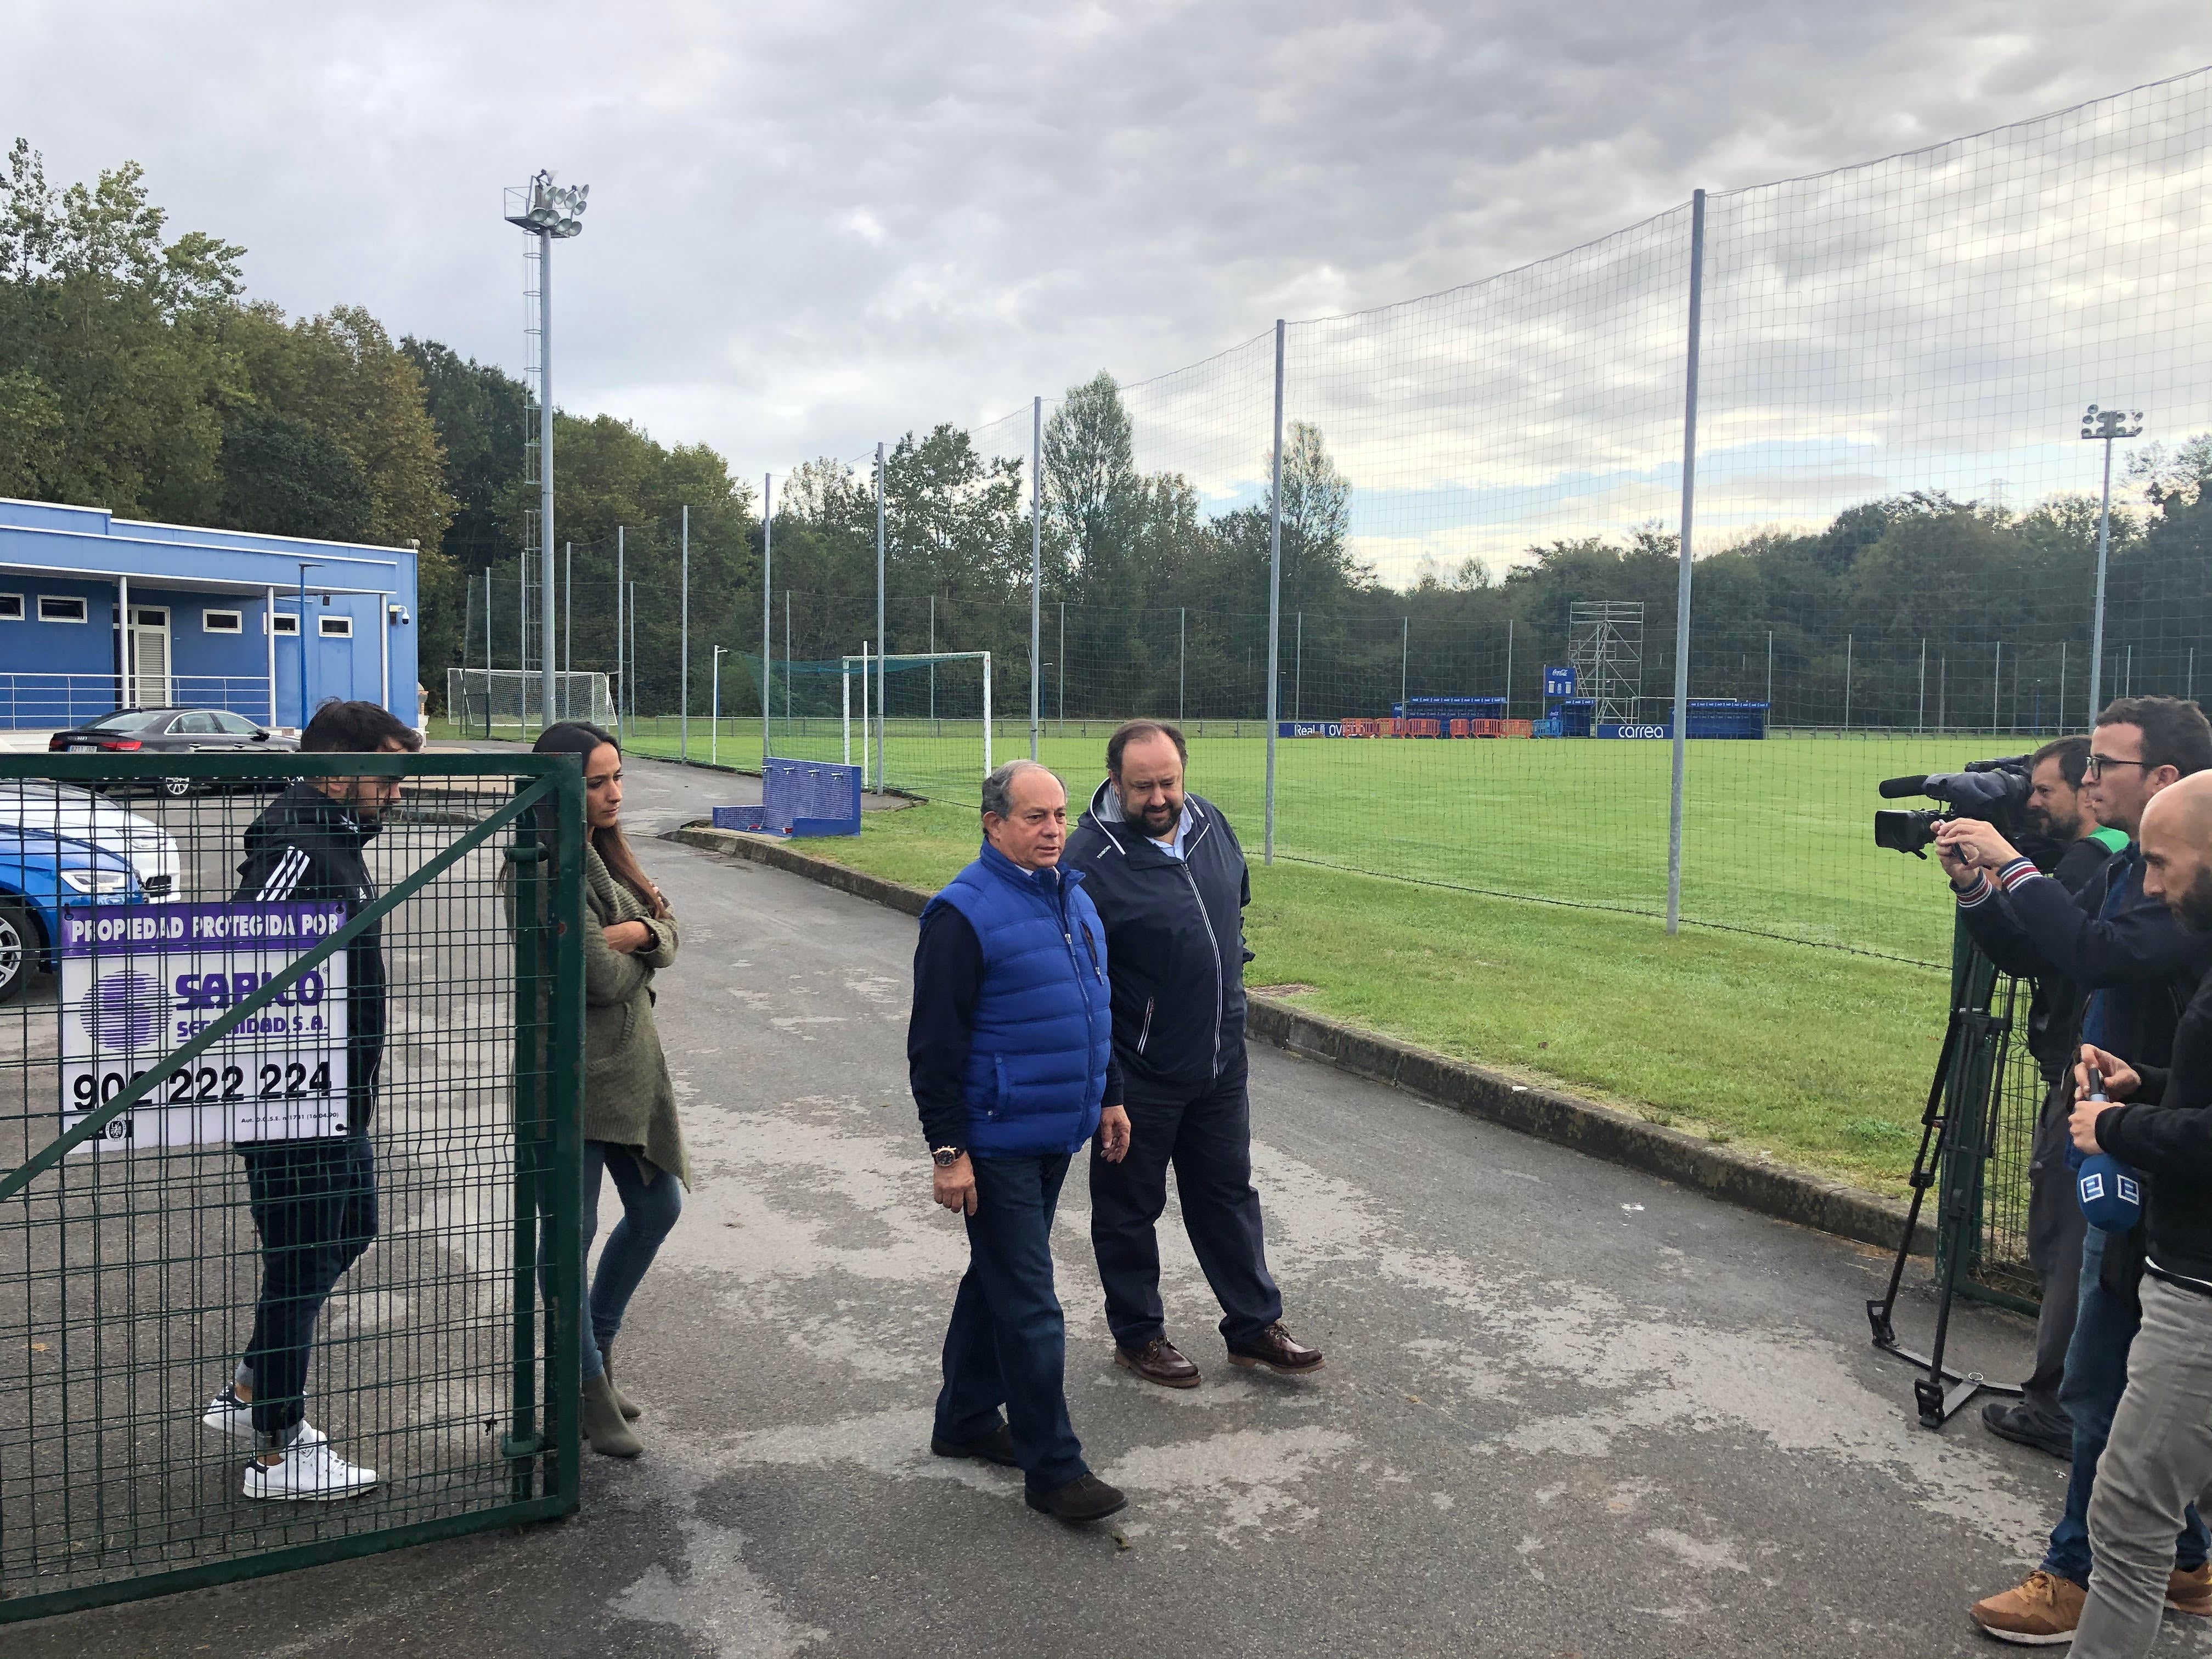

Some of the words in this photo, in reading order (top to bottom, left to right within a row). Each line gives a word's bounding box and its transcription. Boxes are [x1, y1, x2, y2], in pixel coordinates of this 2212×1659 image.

[1294, 724, 1315, 736] Real
[1618, 726, 1664, 738] carrea
[72, 917, 184, 943] PROPIEDAD
[193, 915, 296, 938] PROTEGIDA
[302, 913, 338, 935] POR
[169, 1065, 244, 1104] 222
[259, 1060, 332, 1099] 224
